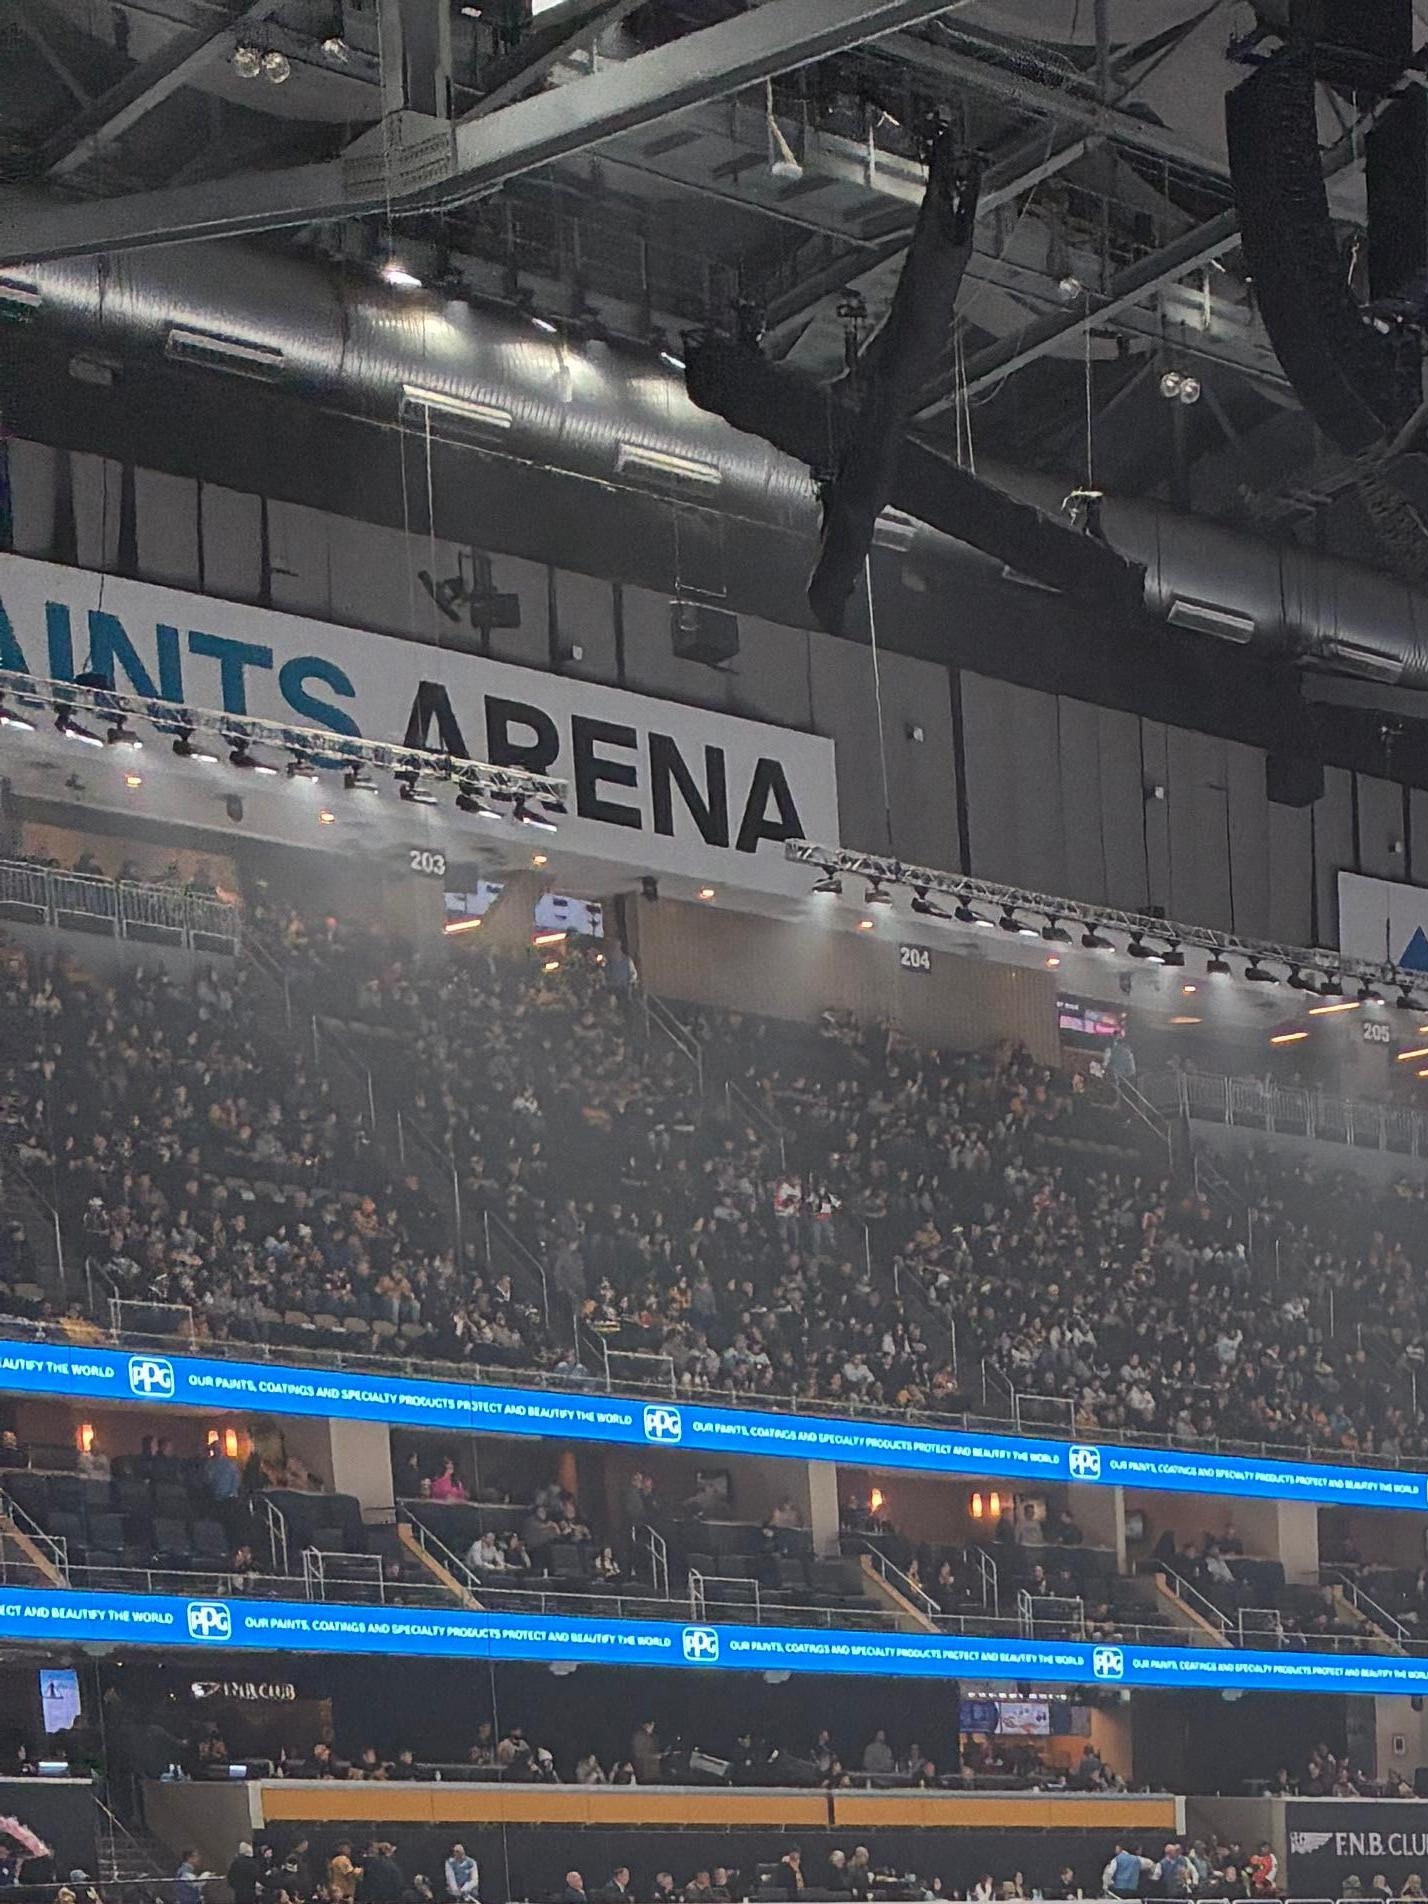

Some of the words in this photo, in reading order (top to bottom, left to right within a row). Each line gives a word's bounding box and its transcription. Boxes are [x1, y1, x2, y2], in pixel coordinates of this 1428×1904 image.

[401, 681, 807, 852] ARENA
[410, 850, 446, 876] 203
[1363, 1022, 1390, 1042] 205
[46, 1361, 69, 1374] THE
[71, 1364, 115, 1378] WORLD
[189, 1374, 214, 1386] OUR
[1336, 1833, 1385, 1856] F.N.B.
